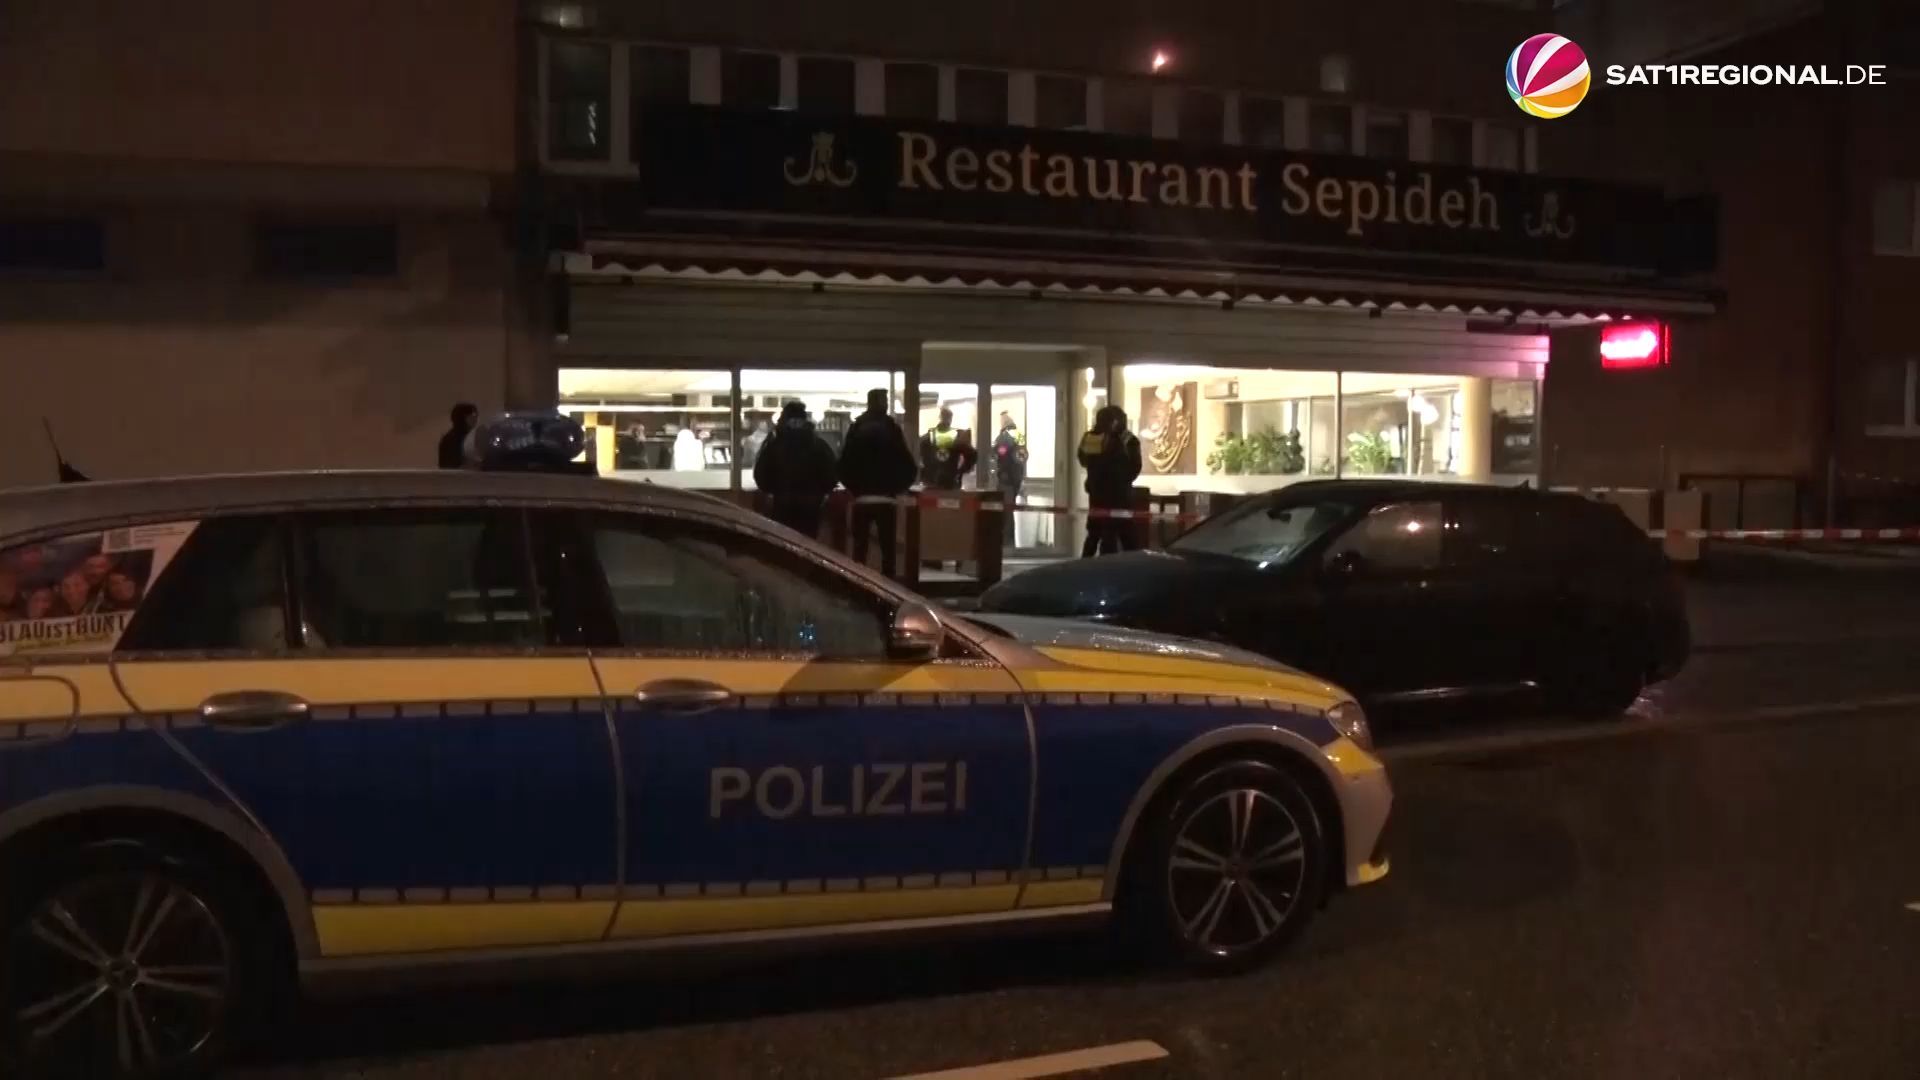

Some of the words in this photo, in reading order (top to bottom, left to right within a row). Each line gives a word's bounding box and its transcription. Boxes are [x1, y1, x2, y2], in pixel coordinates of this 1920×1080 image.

[896, 130, 1258, 212] Restaurant
[1280, 162, 1501, 237] Sepideh
[709, 761, 968, 820] POLIZEI
